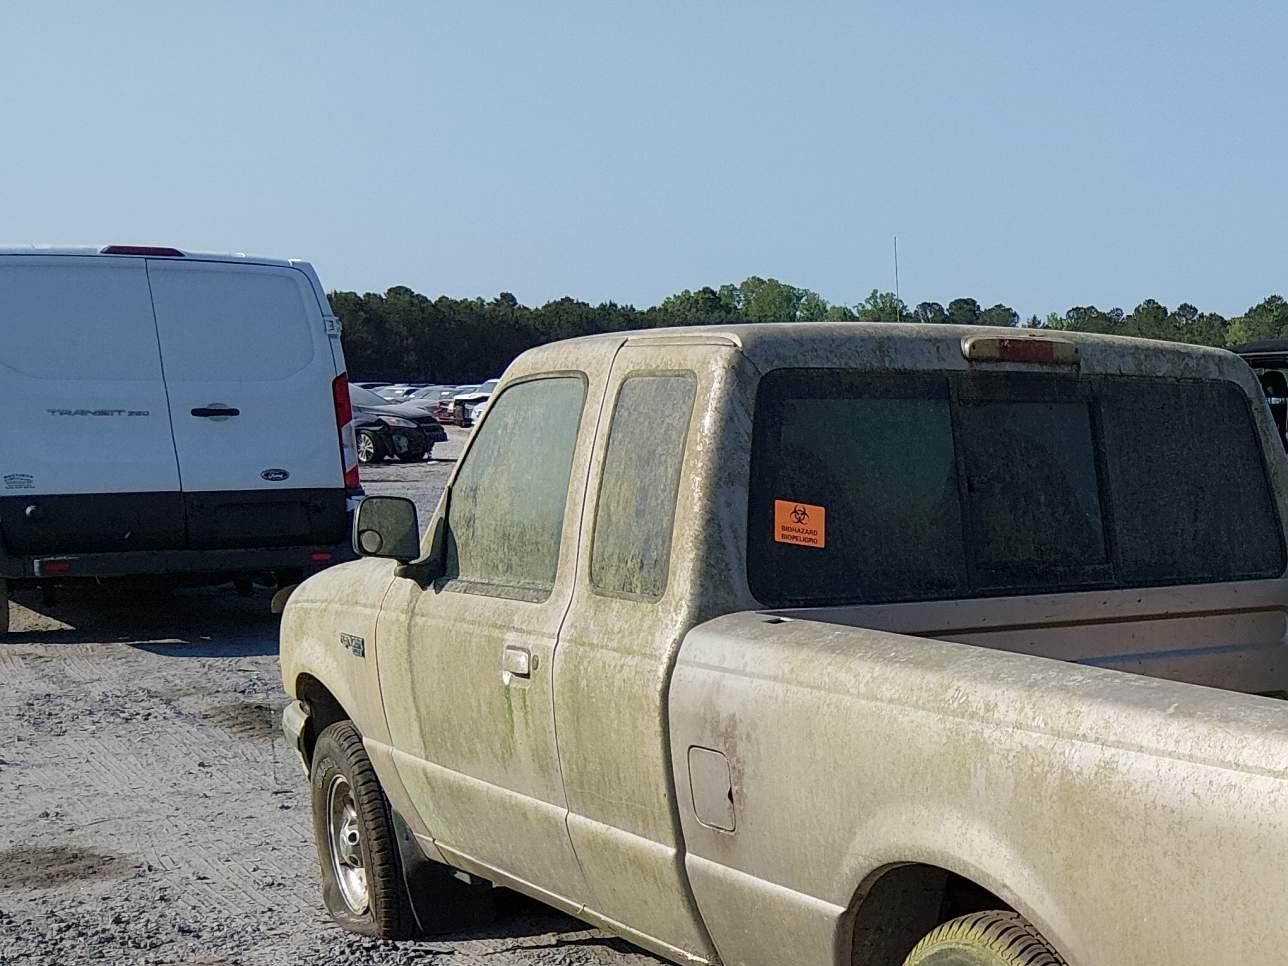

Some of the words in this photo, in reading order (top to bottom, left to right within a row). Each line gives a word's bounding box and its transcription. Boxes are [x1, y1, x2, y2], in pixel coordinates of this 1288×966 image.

[47, 409, 126, 417] TRANSIT
[781, 525, 818, 536] BIOHAZARD
[781, 533, 818, 544] BIOPELIGRO
